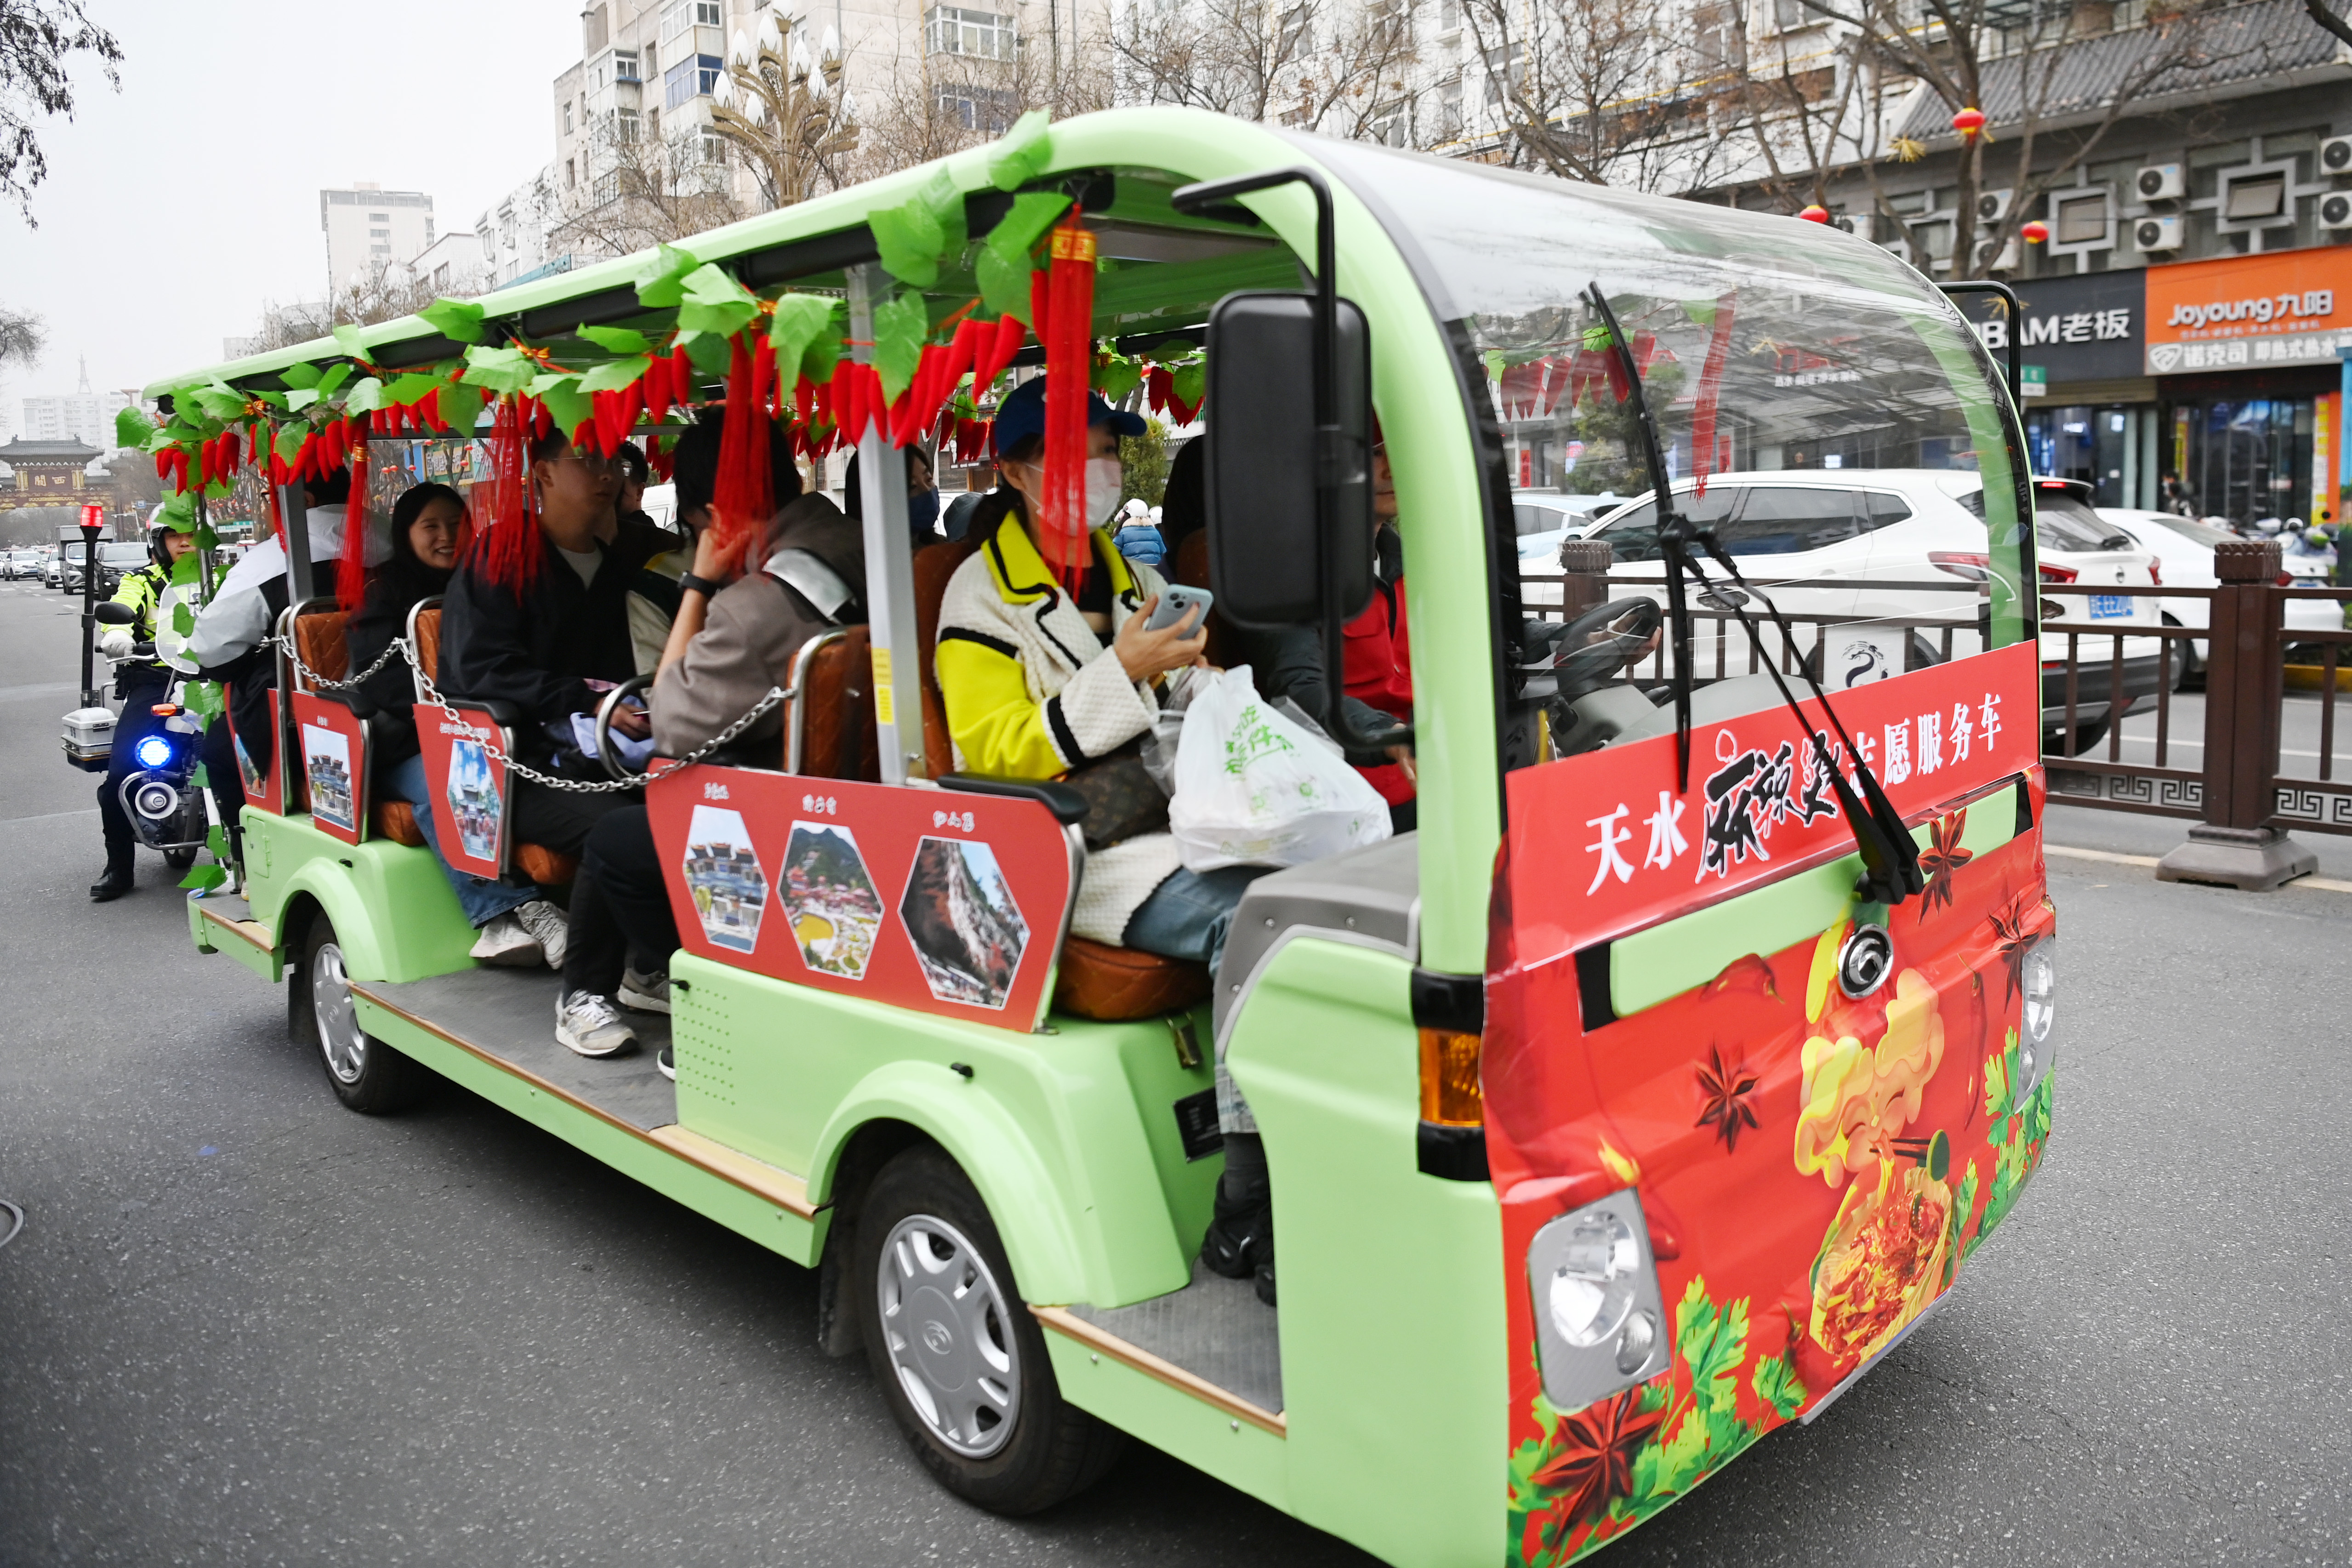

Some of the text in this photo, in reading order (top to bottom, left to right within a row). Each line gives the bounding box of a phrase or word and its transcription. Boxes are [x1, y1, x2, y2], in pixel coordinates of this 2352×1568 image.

[2061, 308, 2130, 342] 老板
[2168, 290, 2333, 328] Joyoung 九阳
